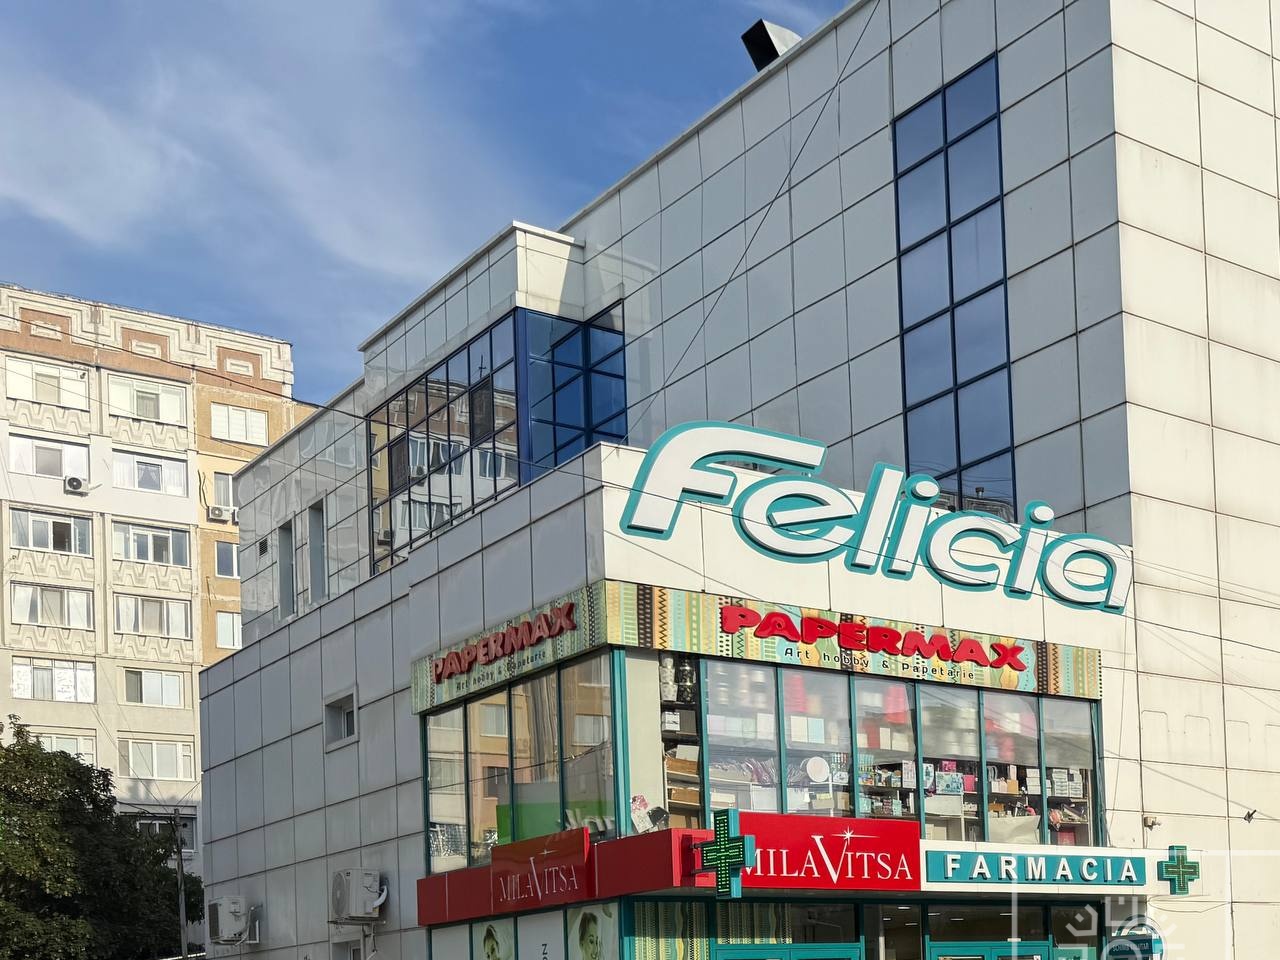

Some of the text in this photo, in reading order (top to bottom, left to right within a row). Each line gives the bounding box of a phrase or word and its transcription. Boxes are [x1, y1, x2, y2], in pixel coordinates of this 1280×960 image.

[620, 421, 1132, 614] Felicia
[431, 602, 577, 684] PAPERMAX
[721, 605, 1027, 672] PAPERMAX
[784, 648, 975, 680] Art hobby & Papetarie
[945, 854, 1137, 881] FARMACIA
